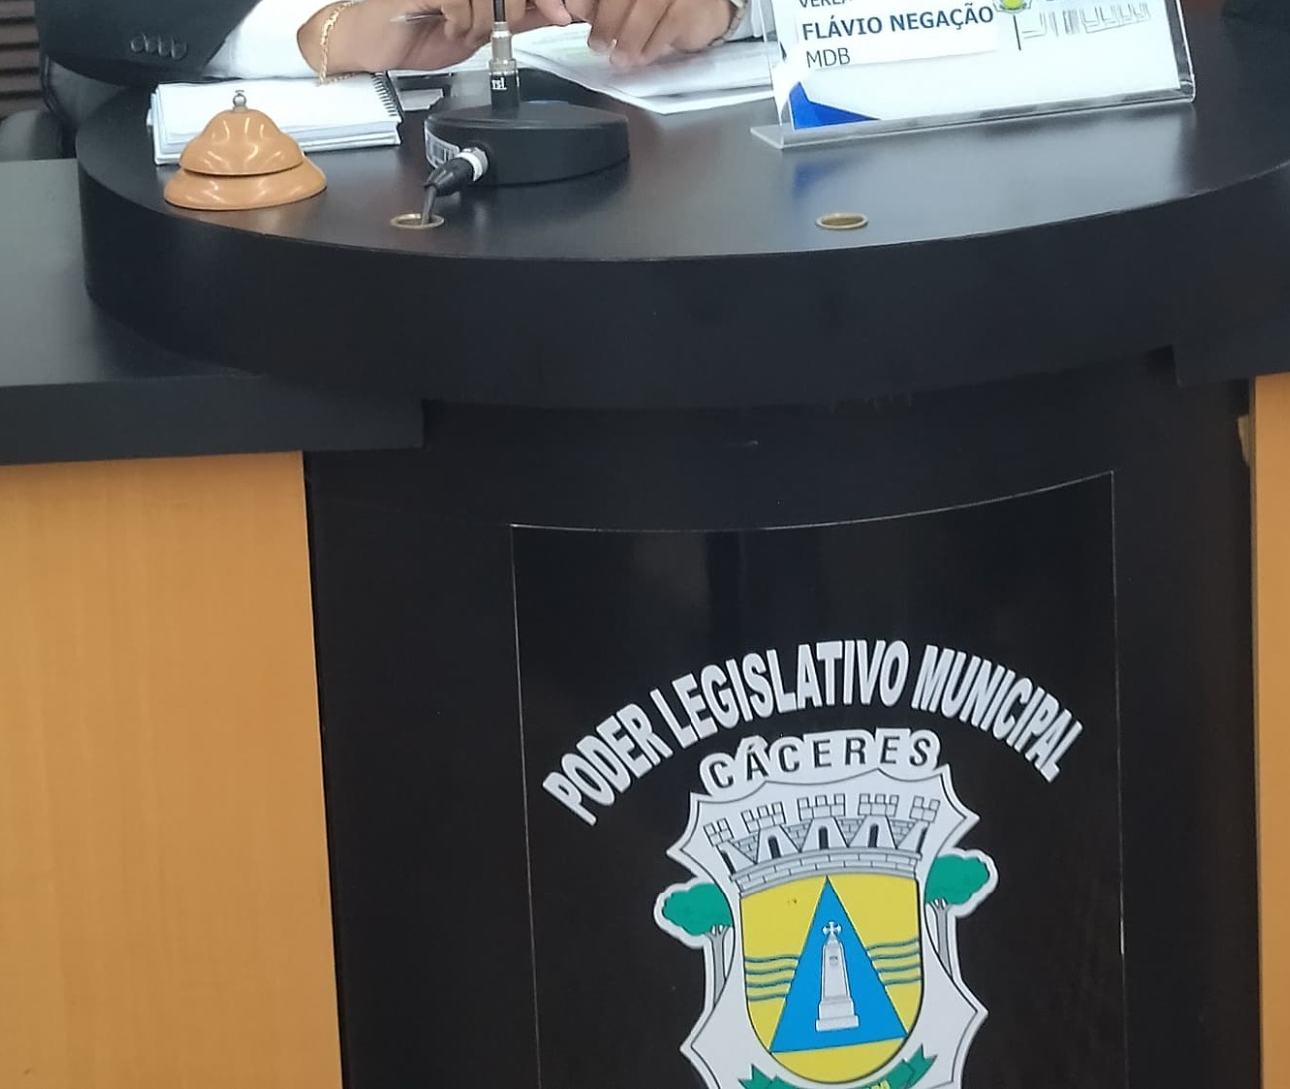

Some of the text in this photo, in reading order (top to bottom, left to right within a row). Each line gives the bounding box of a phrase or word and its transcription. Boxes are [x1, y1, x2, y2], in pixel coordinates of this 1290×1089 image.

[802, 3, 994, 41] FLÁVIO NEGAÇÃO
[806, 47, 851, 69] MDB
[542, 639, 1083, 826] PODER LEGISLATIVO MUNICIPAL
[709, 733, 932, 789] CÁCERES
